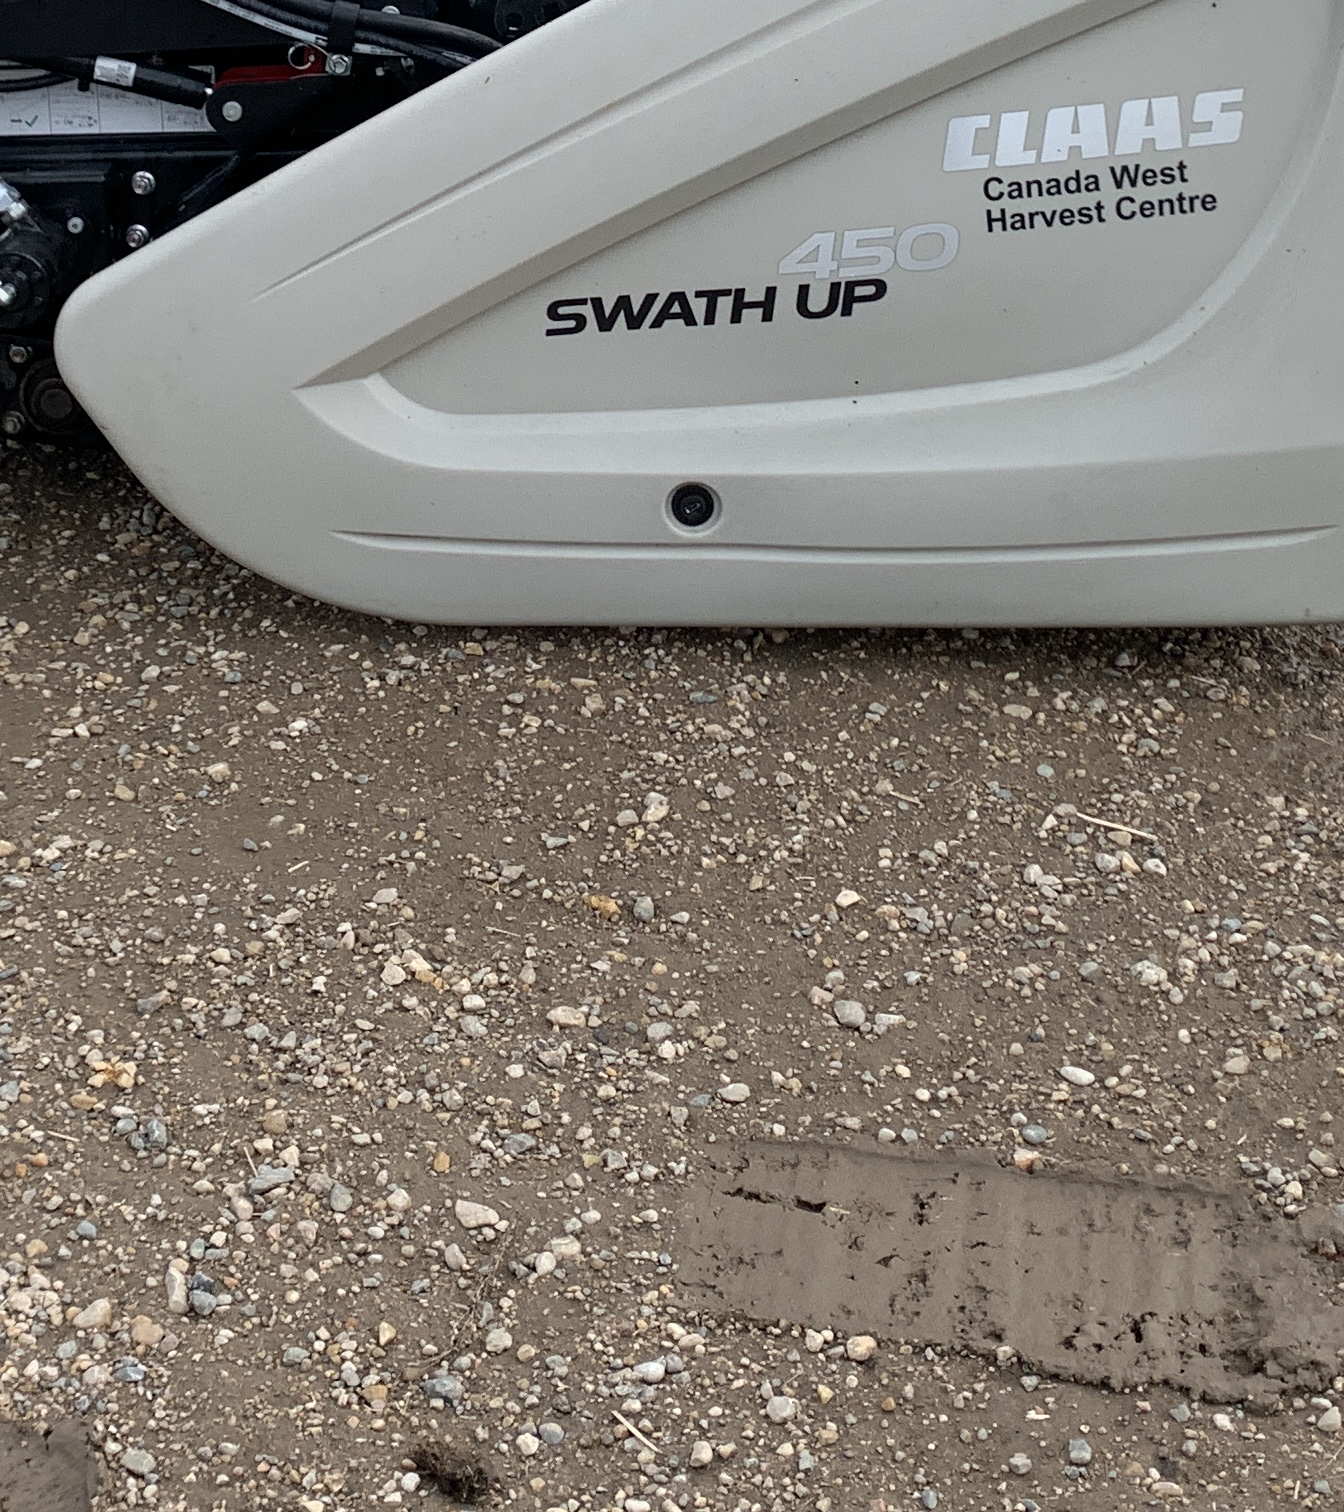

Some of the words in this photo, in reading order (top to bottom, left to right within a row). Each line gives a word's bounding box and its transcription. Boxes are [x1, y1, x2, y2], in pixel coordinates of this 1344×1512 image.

[942, 88, 1244, 172] CLAAS
[983, 169, 1101, 202] Canada
[1109, 159, 1189, 190] West
[985, 200, 1106, 233] Harvest
[1115, 192, 1218, 221] Centre
[778, 222, 960, 280] 450
[545, 286, 778, 337] SWATH
[795, 278, 888, 320] UP
